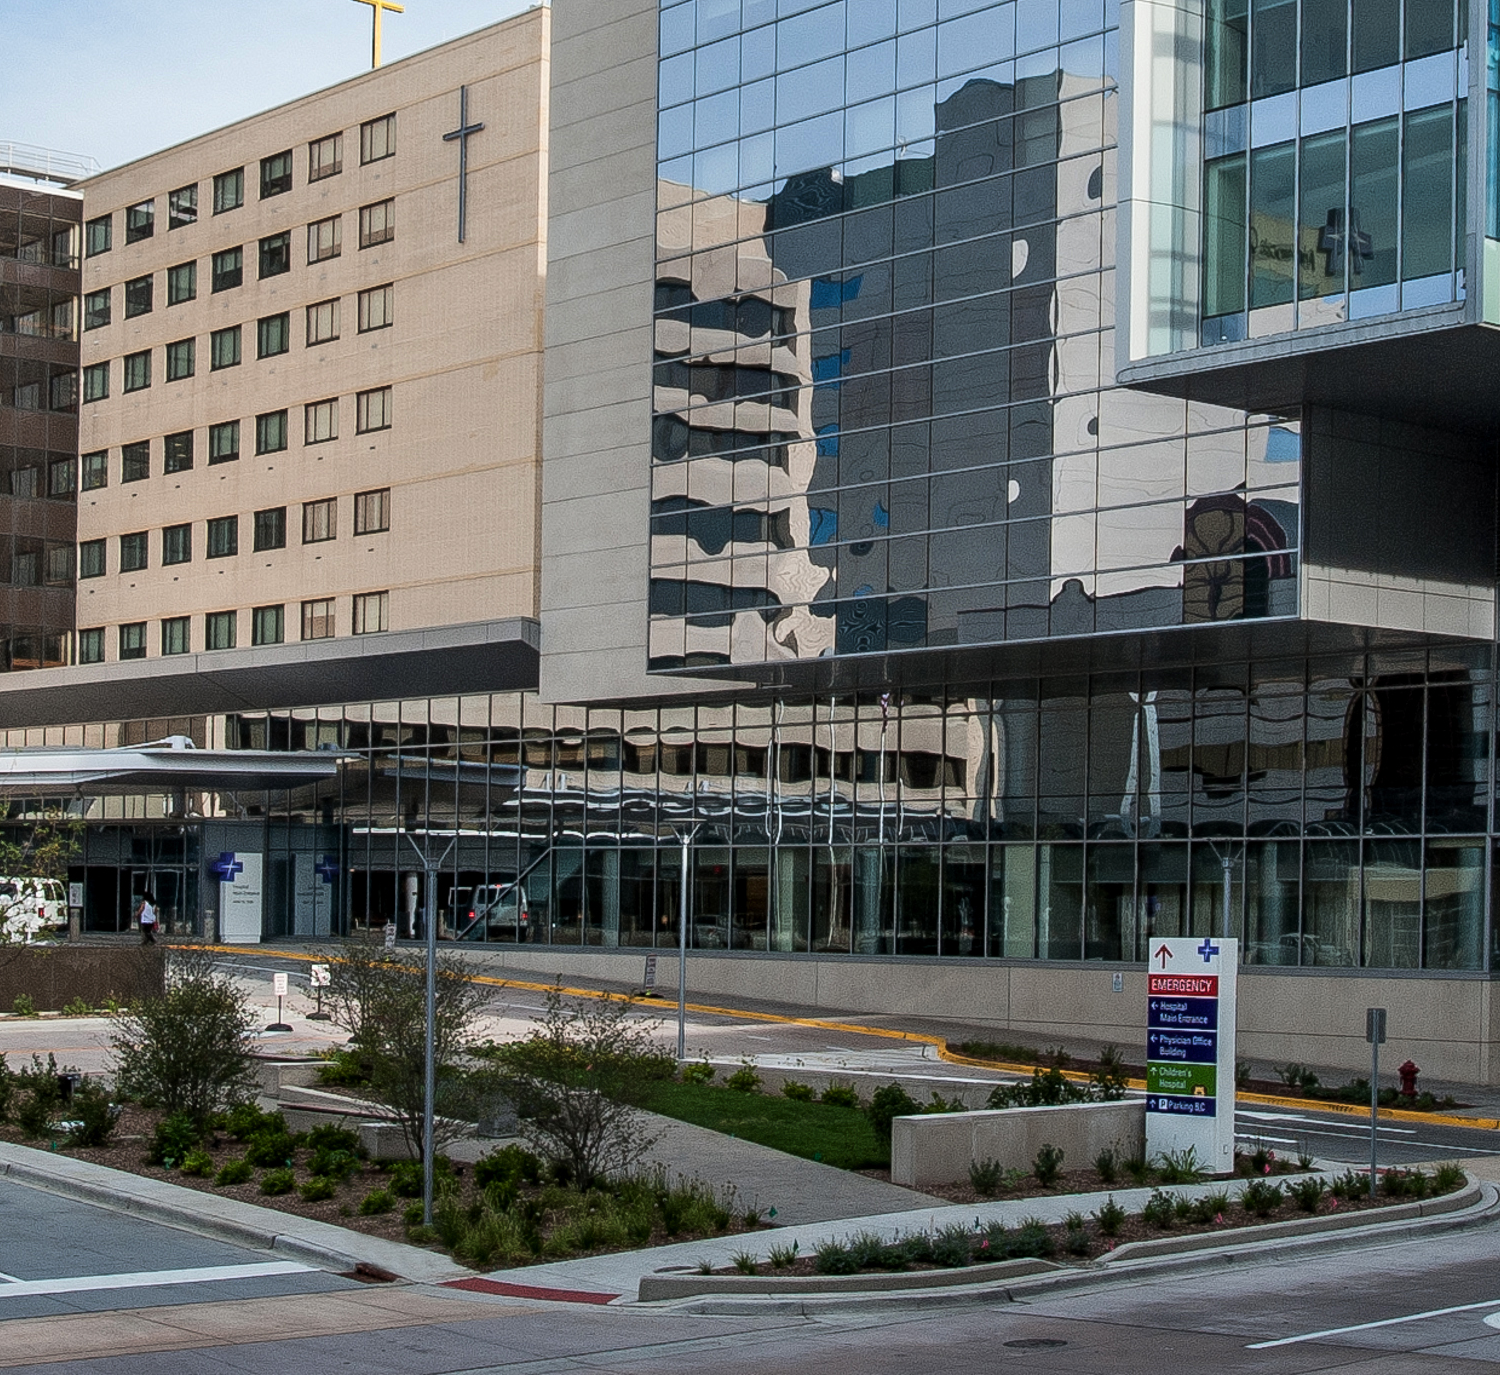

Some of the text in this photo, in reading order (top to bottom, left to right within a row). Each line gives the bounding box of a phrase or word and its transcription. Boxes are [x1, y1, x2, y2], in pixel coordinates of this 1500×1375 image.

[1151, 978, 1212, 992] EMERGENCY
[1160, 1001, 1187, 1011] Hospital
[1160, 1013, 1208, 1024] Main Entrance
[1160, 1034, 1213, 1046] Physician Office
[1160, 1046, 1186, 1058] Building
[1159, 1066, 1192, 1078] Children's
[1159, 1079, 1186, 1089] Hospital
[1168, 1099, 1194, 1113] Parking
